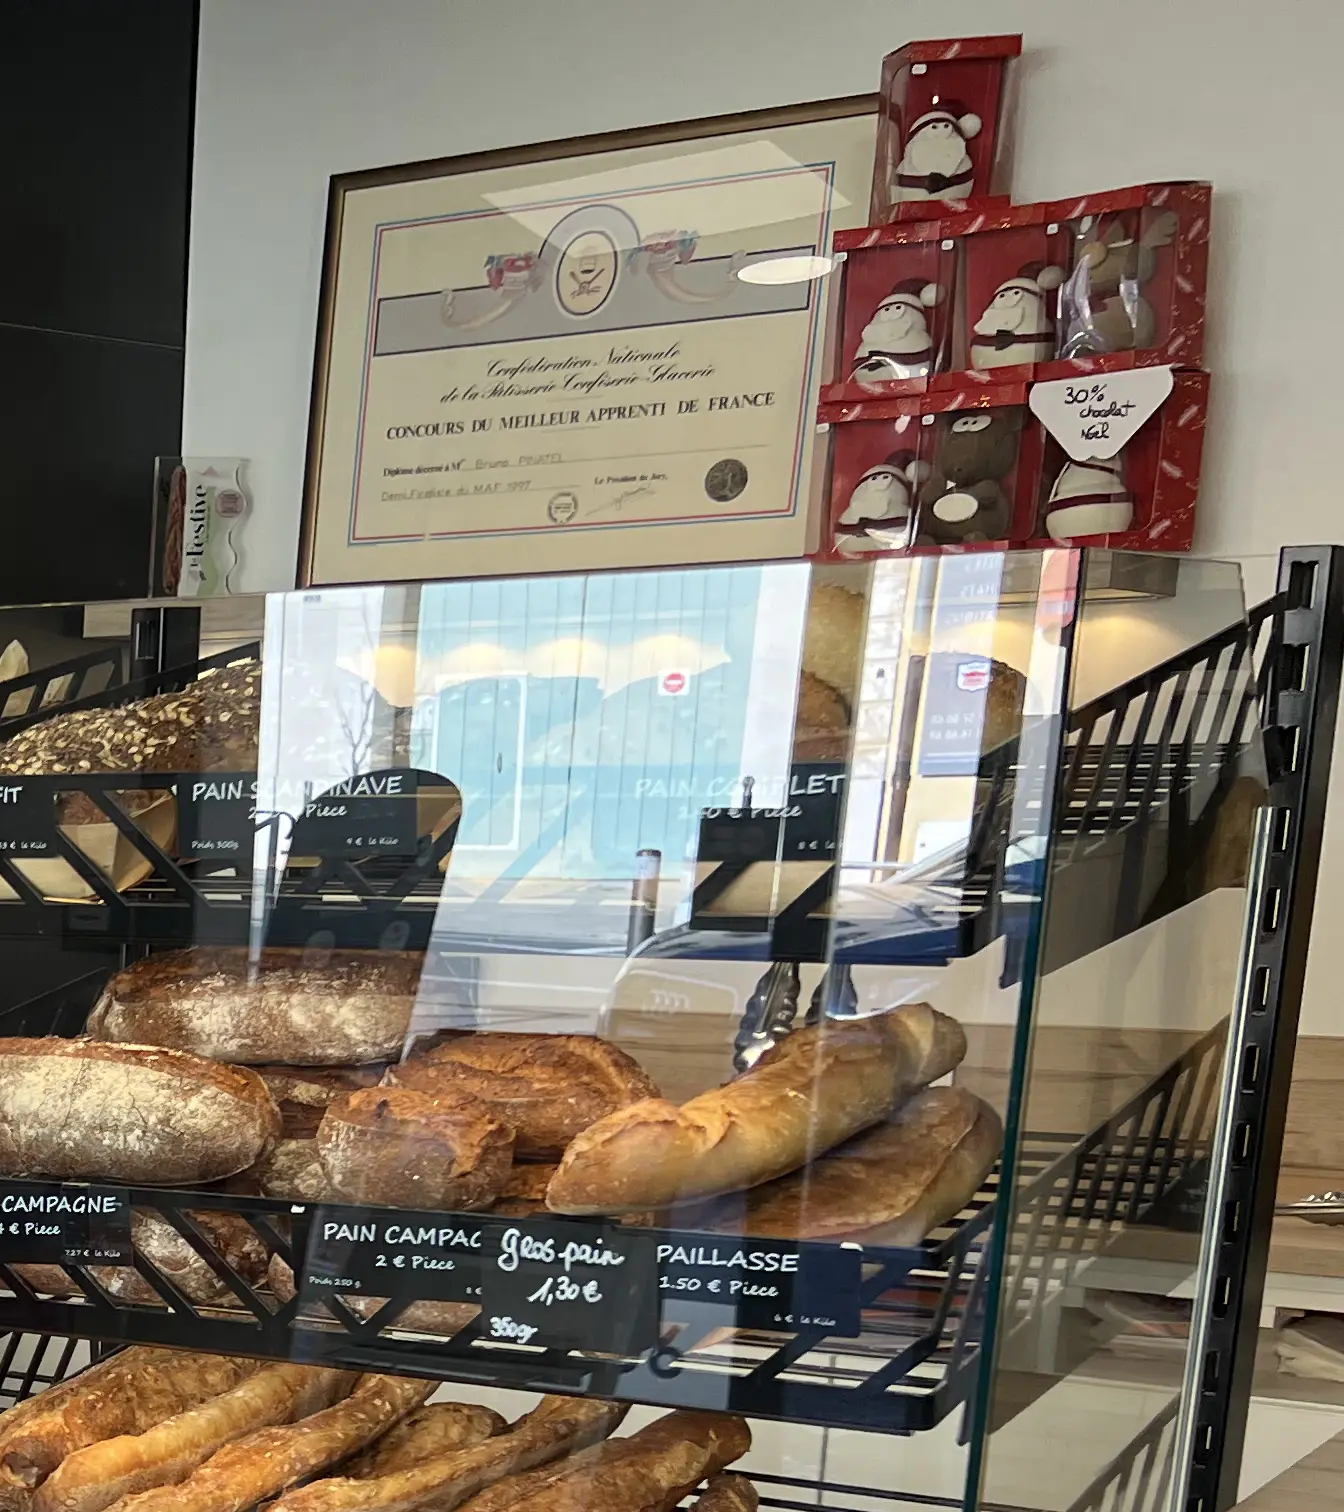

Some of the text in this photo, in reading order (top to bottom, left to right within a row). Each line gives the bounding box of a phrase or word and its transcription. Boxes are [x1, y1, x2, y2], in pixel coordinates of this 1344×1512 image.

[1064, 384, 1107, 404] 30%
[387, 391, 775, 440] CONCOURS DU MEILLEUR APPRENTI DE FRANCE
[192, 779, 243, 801] PAIN
[1, 1195, 117, 1213] CAMPAGNE
[323, 1222, 377, 1242] PAIN
[375, 1255, 385, 1268] 2
[656, 1244, 800, 1273] PAILLASSE
[659, 1275, 701, 1291] 1.50
[707, 1278, 720, 1293] €
